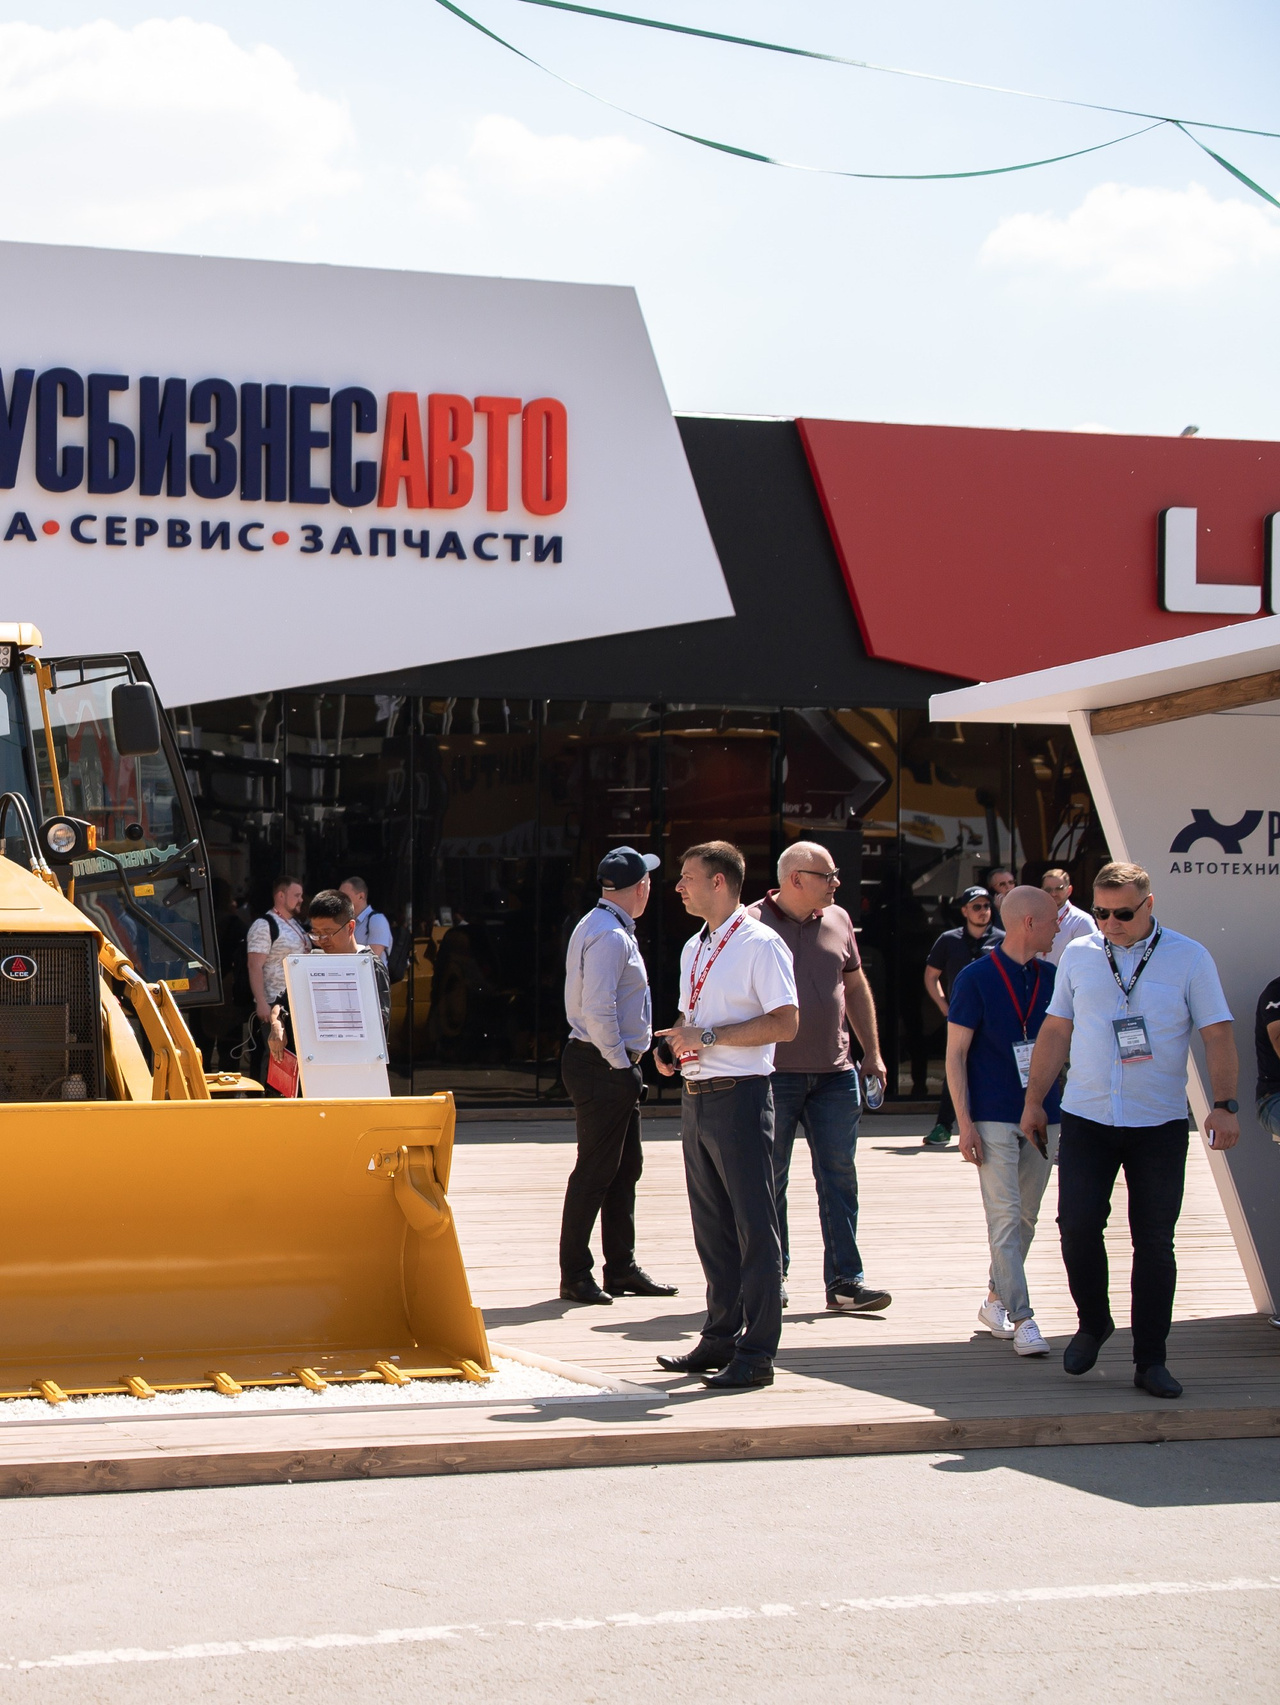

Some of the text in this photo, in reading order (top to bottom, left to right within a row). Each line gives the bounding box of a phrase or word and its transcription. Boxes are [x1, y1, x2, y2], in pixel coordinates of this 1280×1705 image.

[70, 514, 265, 552] СЕРВИС
[300, 525, 563, 564] ЗАПЧАСТИ
[1157, 506, 1280, 616] L
